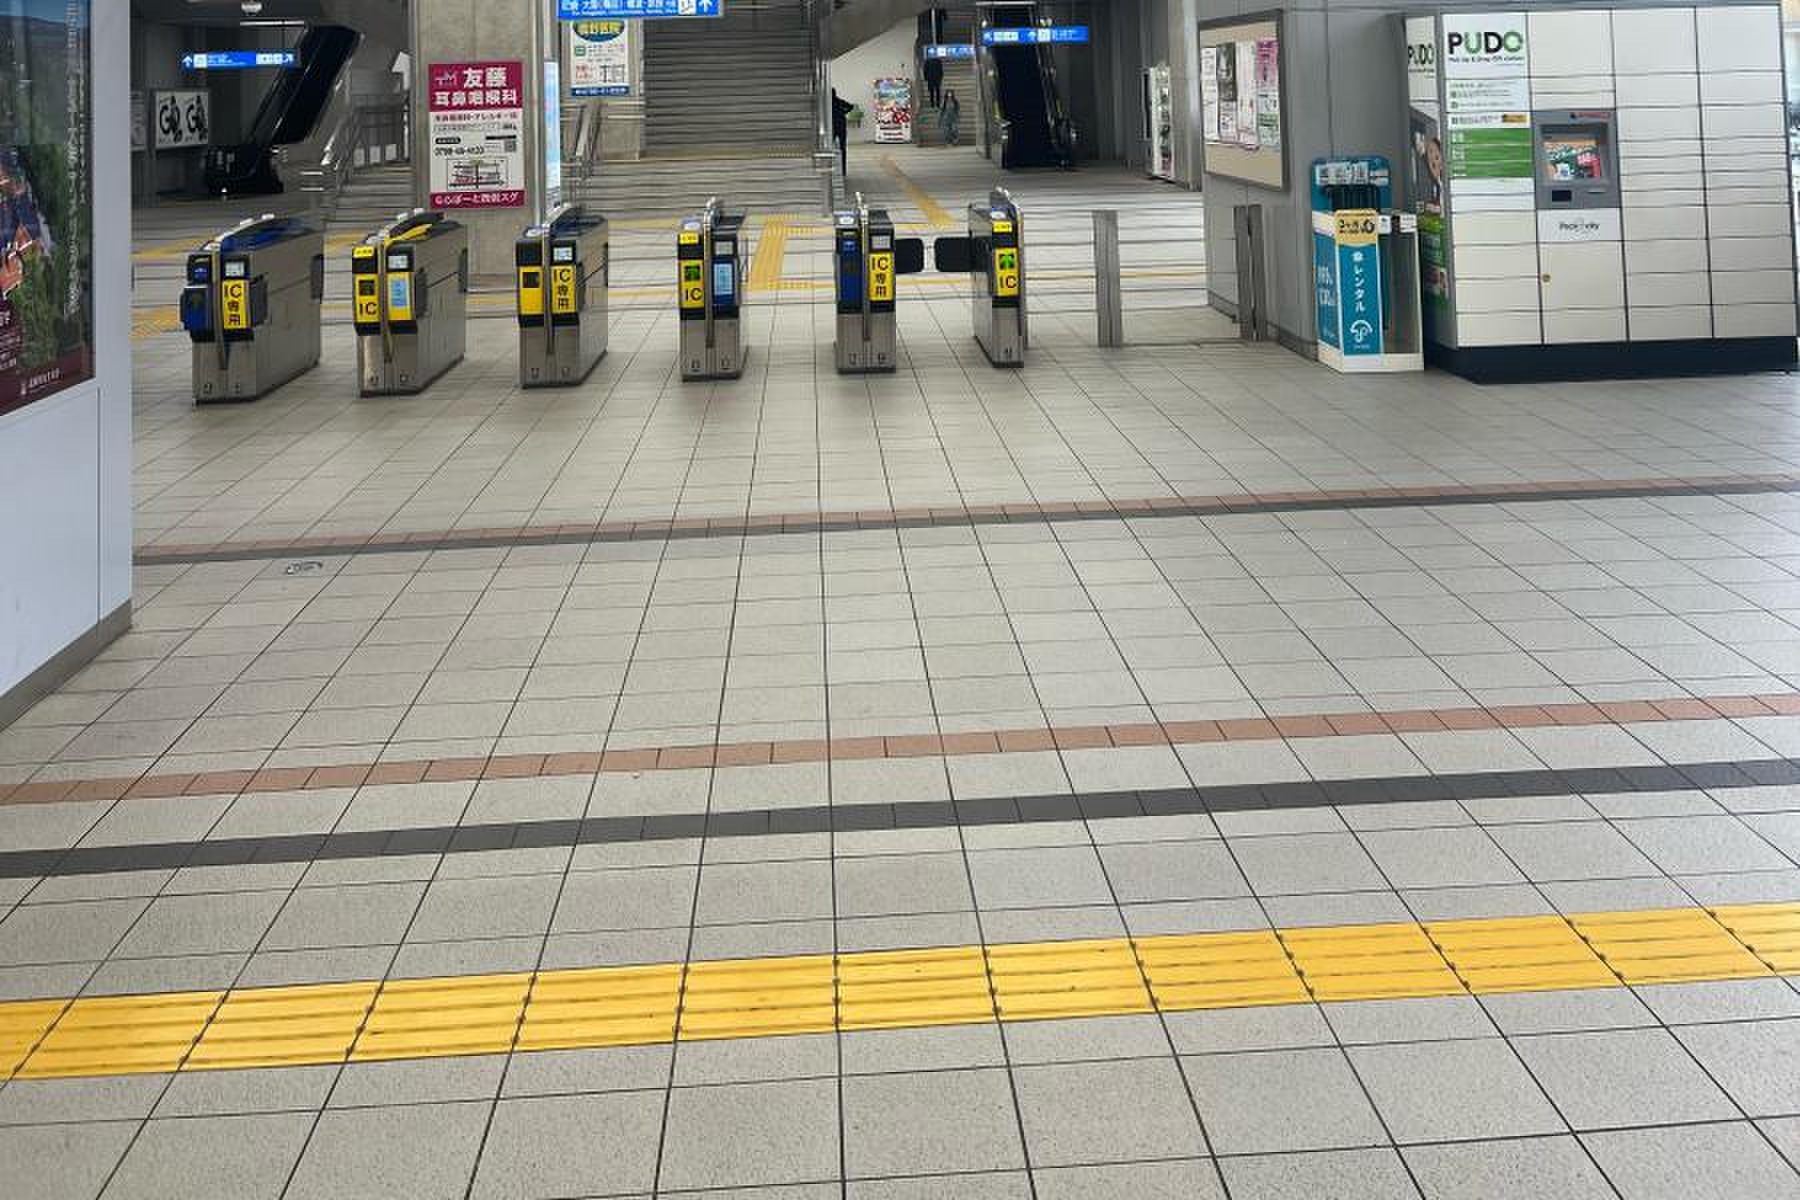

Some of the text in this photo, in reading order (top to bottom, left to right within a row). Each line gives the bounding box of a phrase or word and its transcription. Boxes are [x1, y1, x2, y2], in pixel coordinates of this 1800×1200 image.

[1447, 30, 1524, 55] PUDO
[871, 256, 889, 271] IC
[553, 268, 572, 283] IC
[999, 275, 1017, 289] IC
[223, 284, 242, 299] IC
[685, 287, 704, 301] IC
[359, 302, 377, 316] IC
